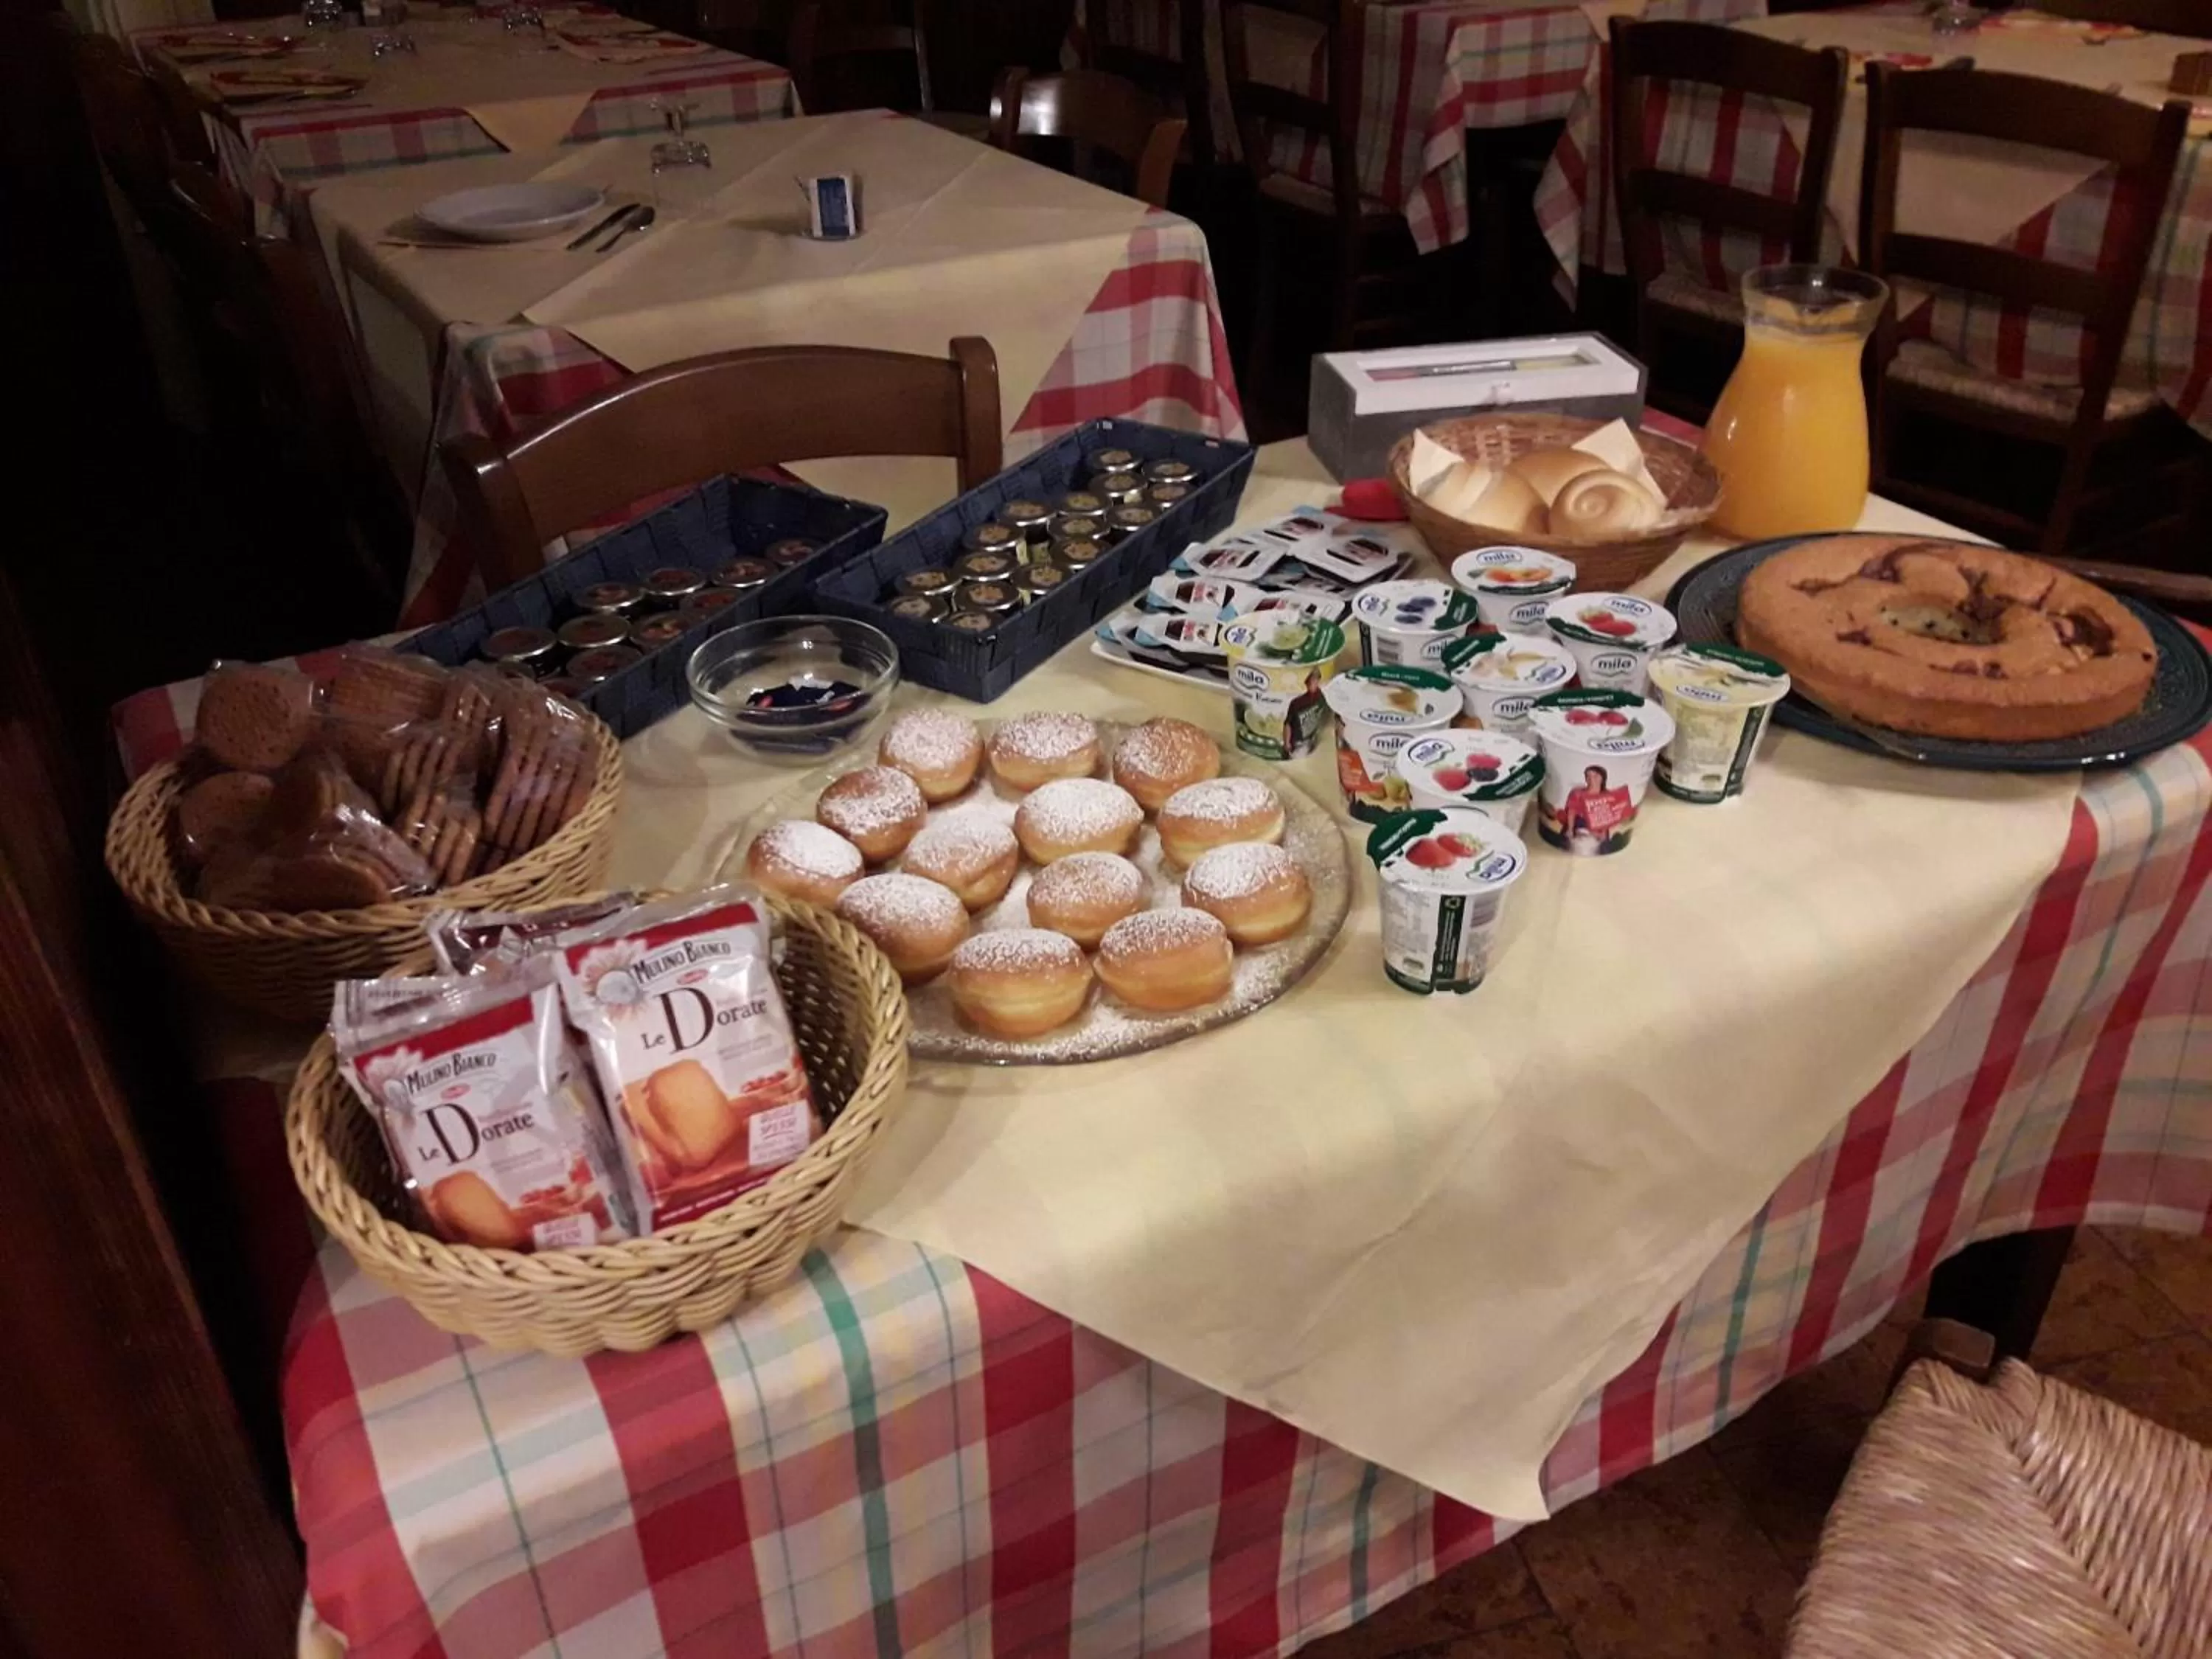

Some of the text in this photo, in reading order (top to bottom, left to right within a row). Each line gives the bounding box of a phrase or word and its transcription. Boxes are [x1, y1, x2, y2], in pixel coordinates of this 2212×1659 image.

[1517, 605, 1545, 619] mila
[1597, 658, 1632, 670] mila
[1238, 668, 1265, 685] mila
[653, 986, 768, 1055] Dorate
[641, 1032, 666, 1050] Le
[419, 1102, 535, 1167] Dorate
[417, 1146, 440, 1161] Le
